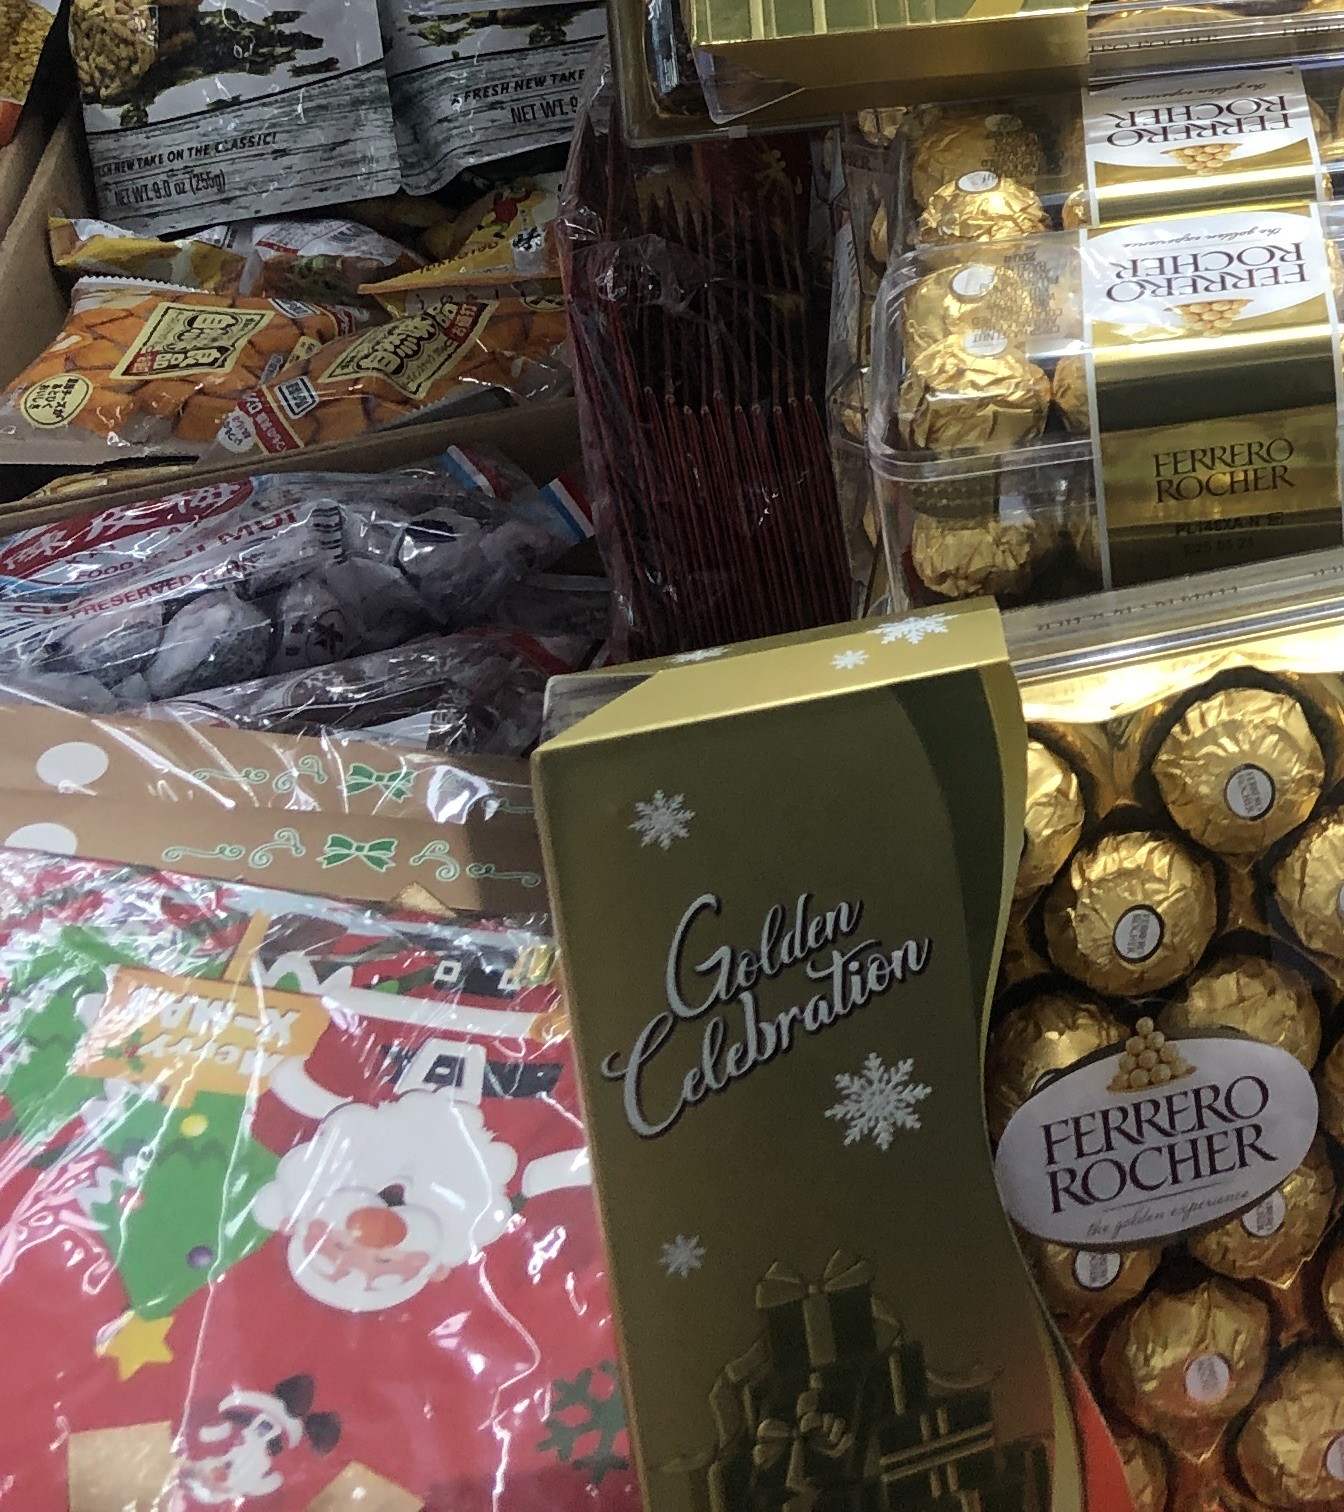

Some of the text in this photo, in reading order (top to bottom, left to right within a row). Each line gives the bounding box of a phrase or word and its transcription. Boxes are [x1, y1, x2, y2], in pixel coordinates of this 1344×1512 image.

[463, 69, 586, 104] FRESH NEW TAKE
[1105, 94, 1289, 134] ROCHER
[1107, 112, 1293, 148] FERRERO
[1111, 242, 1304, 283] ROCHER
[1153, 436, 1295, 479] FERRERO
[1154, 463, 1295, 505] ROCHER
[665, 892, 863, 1021] Golden
[601, 937, 933, 1140] Celebration
[1040, 1073, 1270, 1167] FERRERO
[1047, 1121, 1277, 1216] ROCHER
